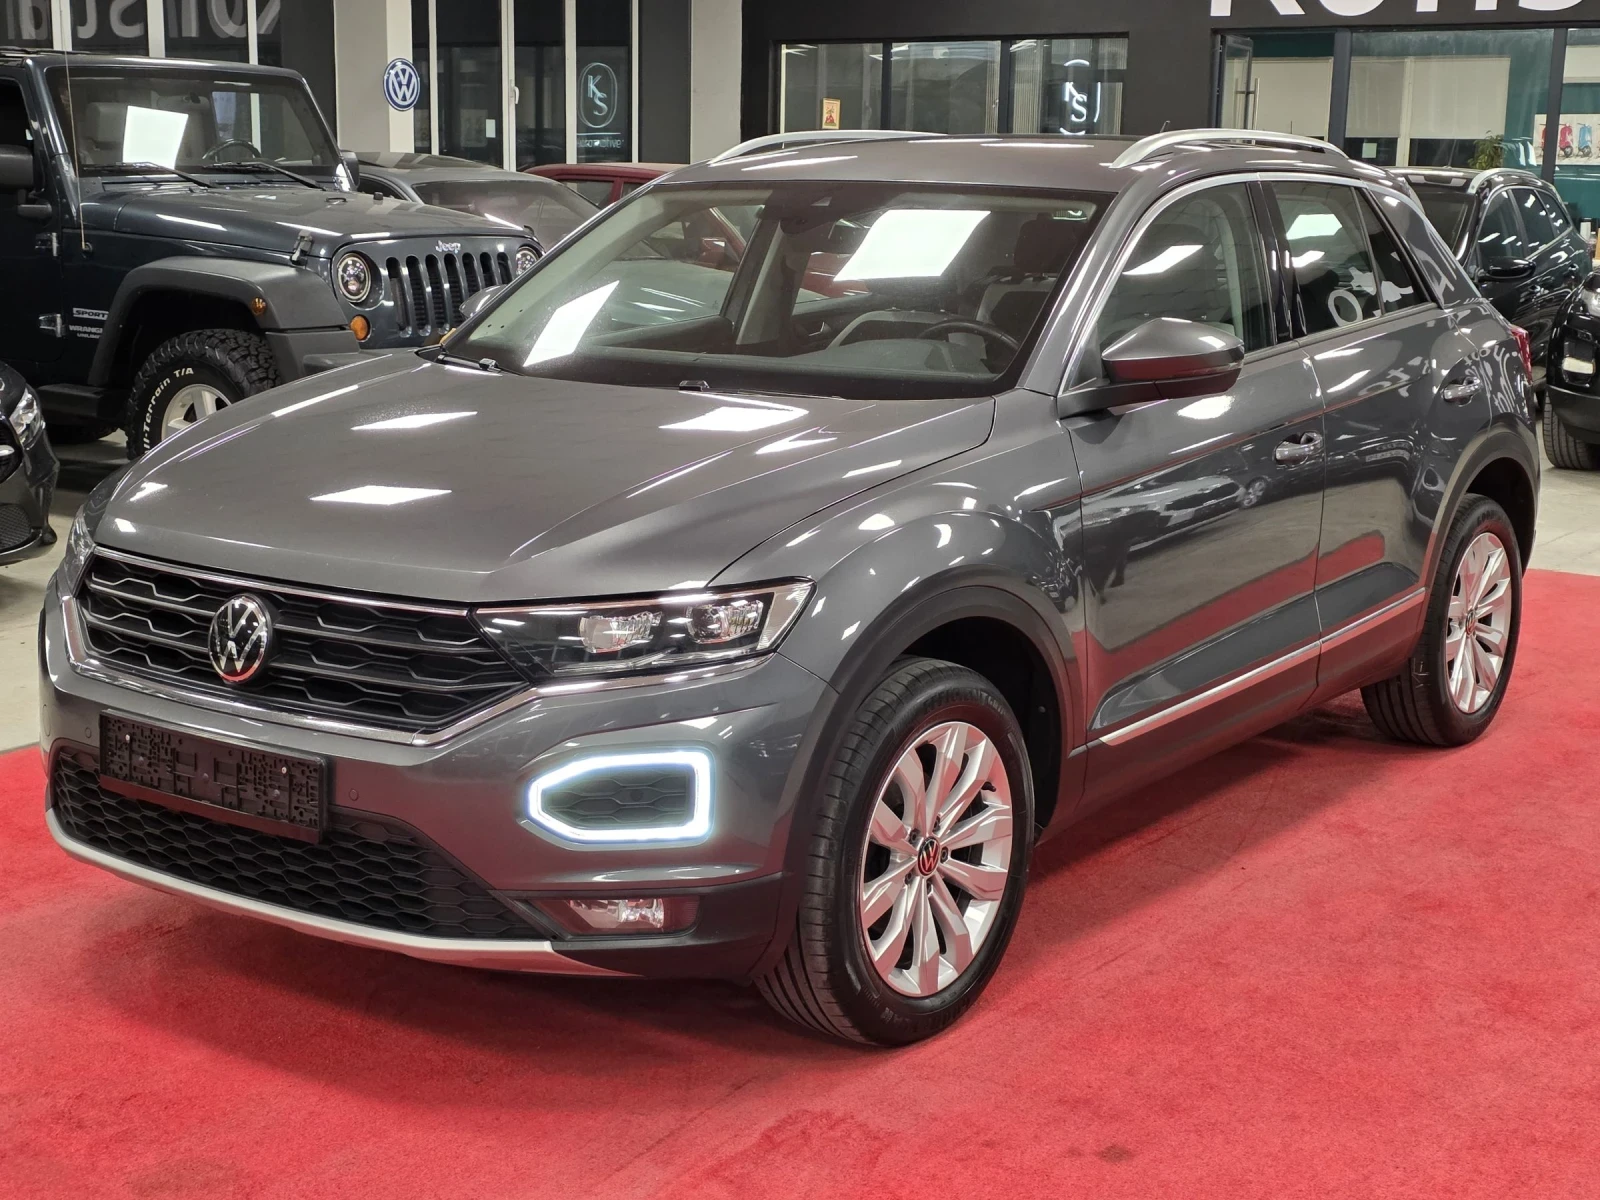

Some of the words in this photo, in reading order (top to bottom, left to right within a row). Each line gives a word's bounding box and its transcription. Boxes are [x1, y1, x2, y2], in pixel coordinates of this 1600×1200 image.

[435, 240, 461, 254] Jeep
[74, 309, 108, 319] SPORT
[173, 367, 195, 378] T/A
